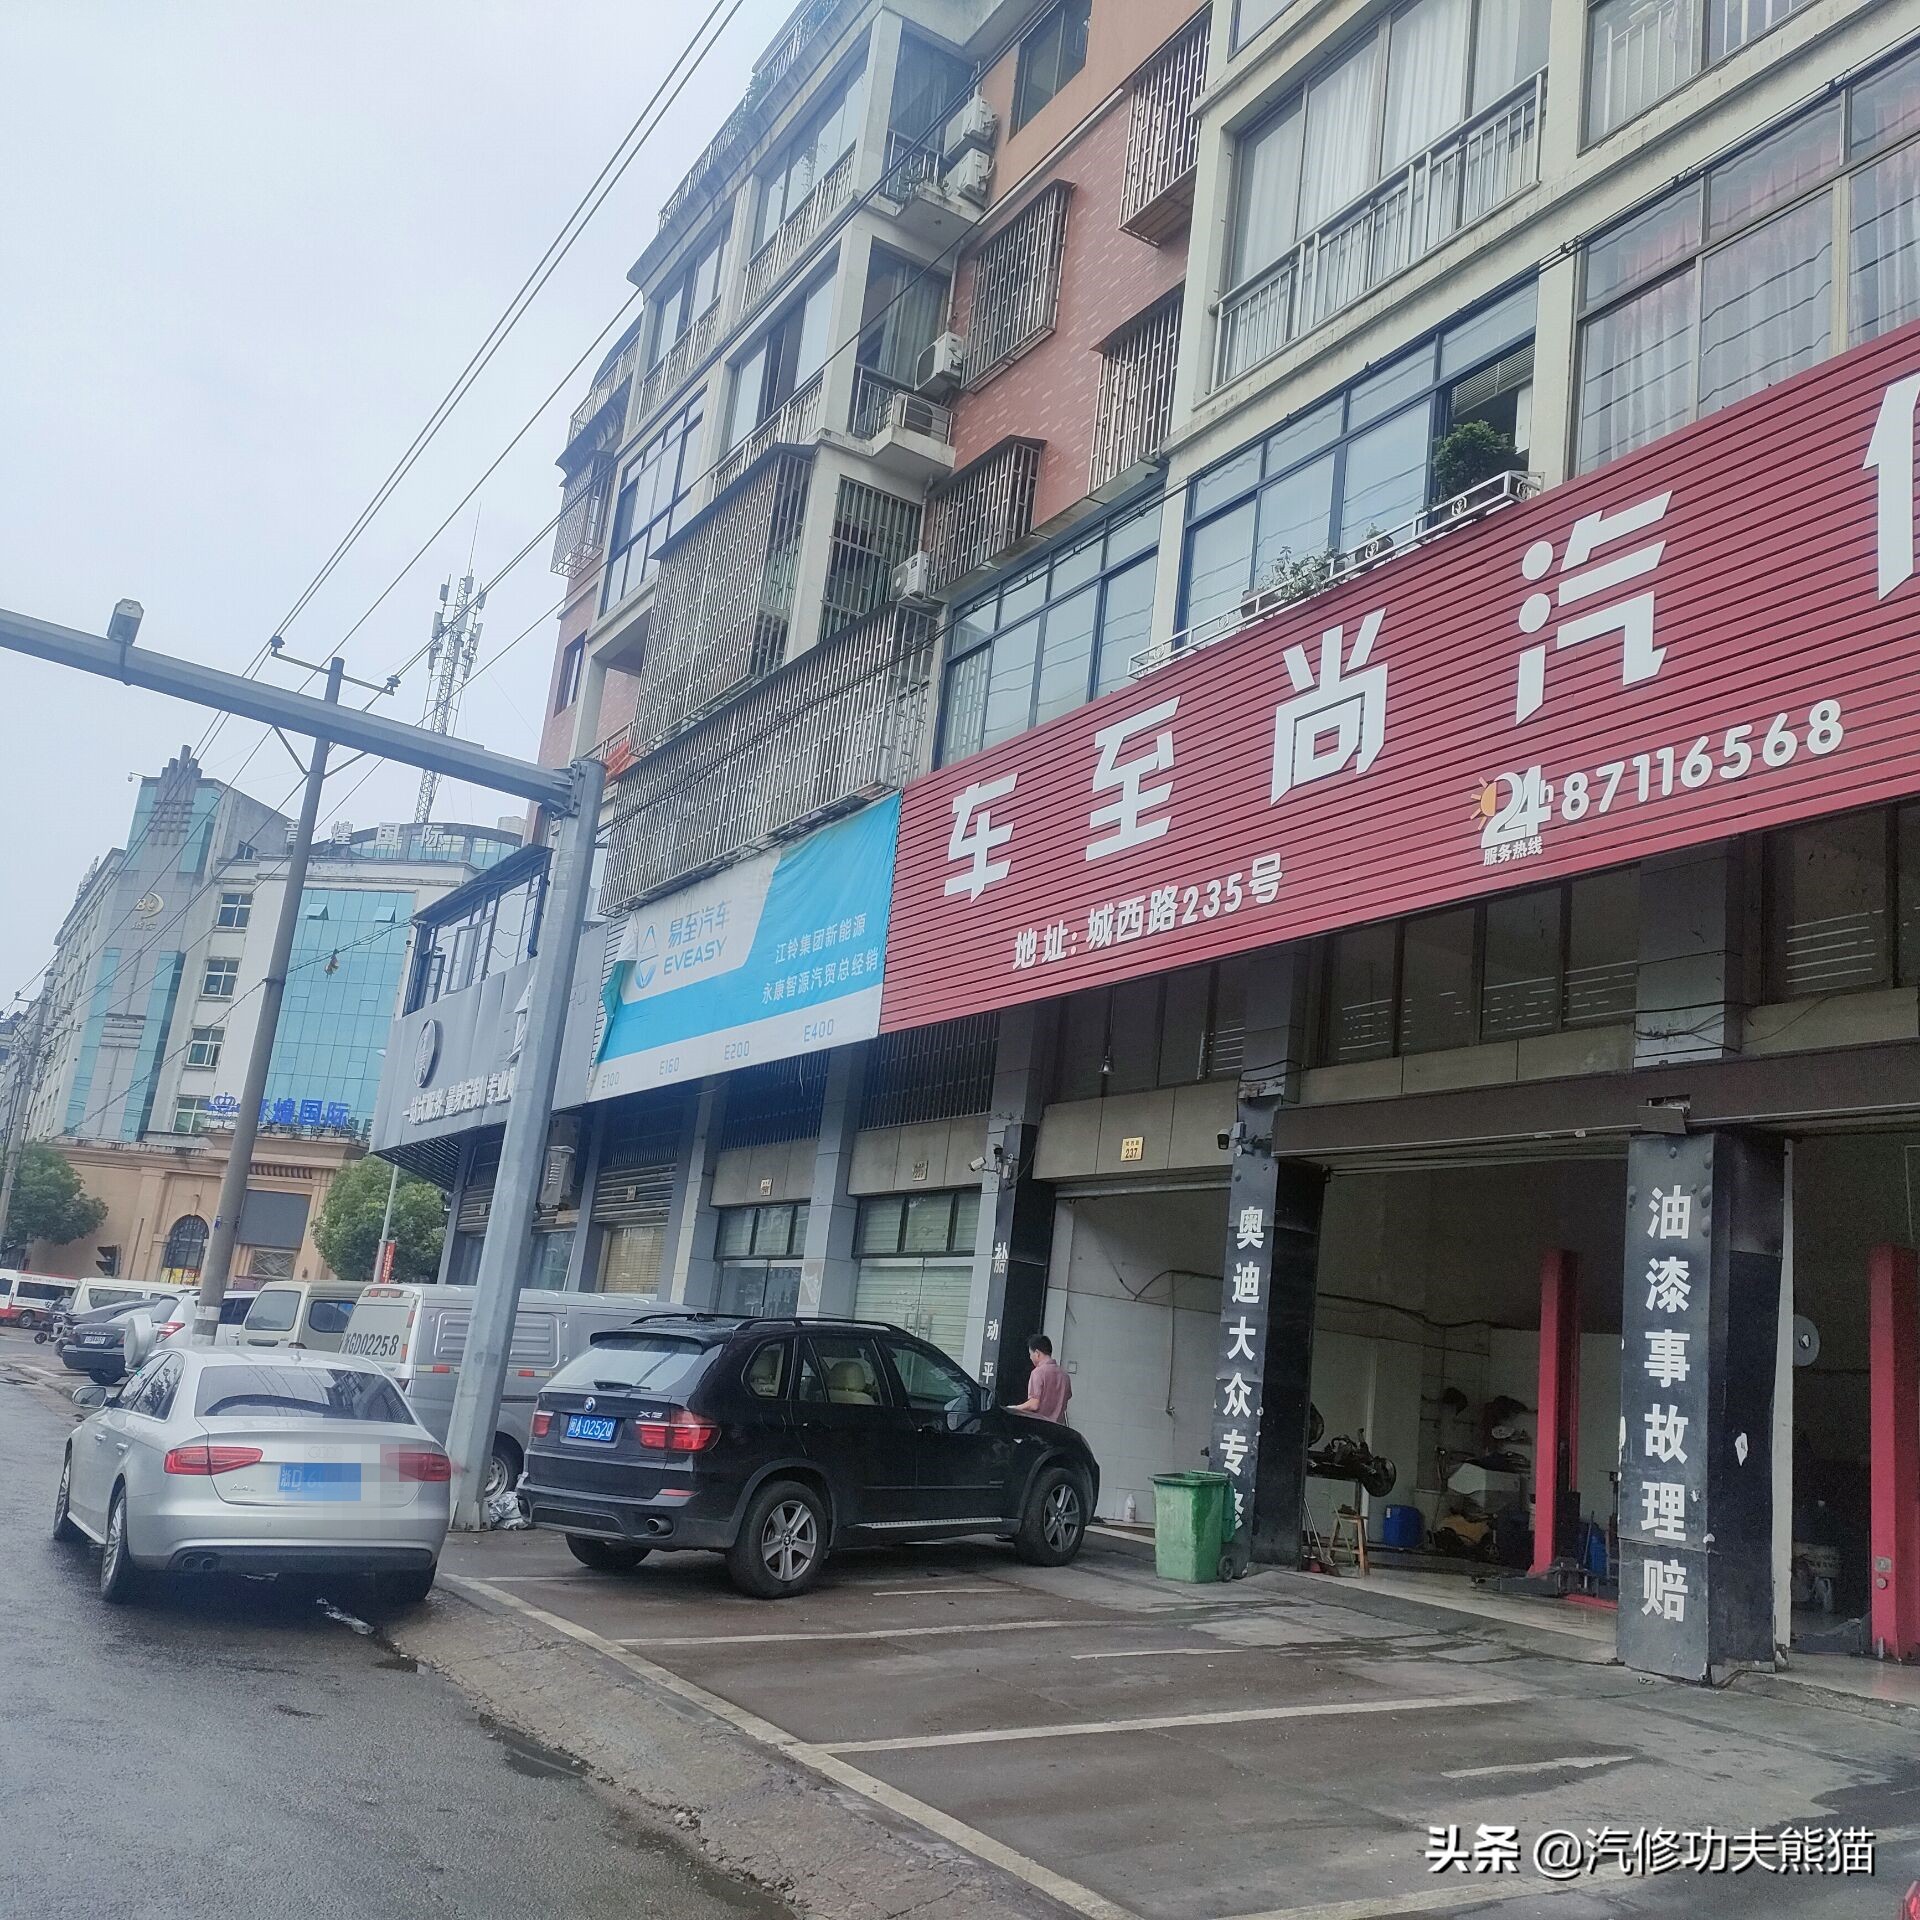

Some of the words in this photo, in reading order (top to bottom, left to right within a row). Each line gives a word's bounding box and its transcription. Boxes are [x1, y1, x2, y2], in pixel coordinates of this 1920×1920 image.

[1561, 699, 1844, 821] 87116568
[1483, 836, 1544, 867] 服务热线
[668, 900, 732, 949] 易至汽车
[775, 912, 867, 965] 江铃集团新能源
[663, 935, 728, 976] EVEASY
[761, 946, 879, 1005] 永康智源汽贸总经销
[803, 1018, 834, 1043] E400
[659, 1056, 680, 1076] E160
[724, 1039, 750, 1060] E200
[601, 1071, 621, 1089] E100
[1125, 1148, 1138, 1159] 237
[1641, 1185, 1692, 1623] 油漆事故理赔
